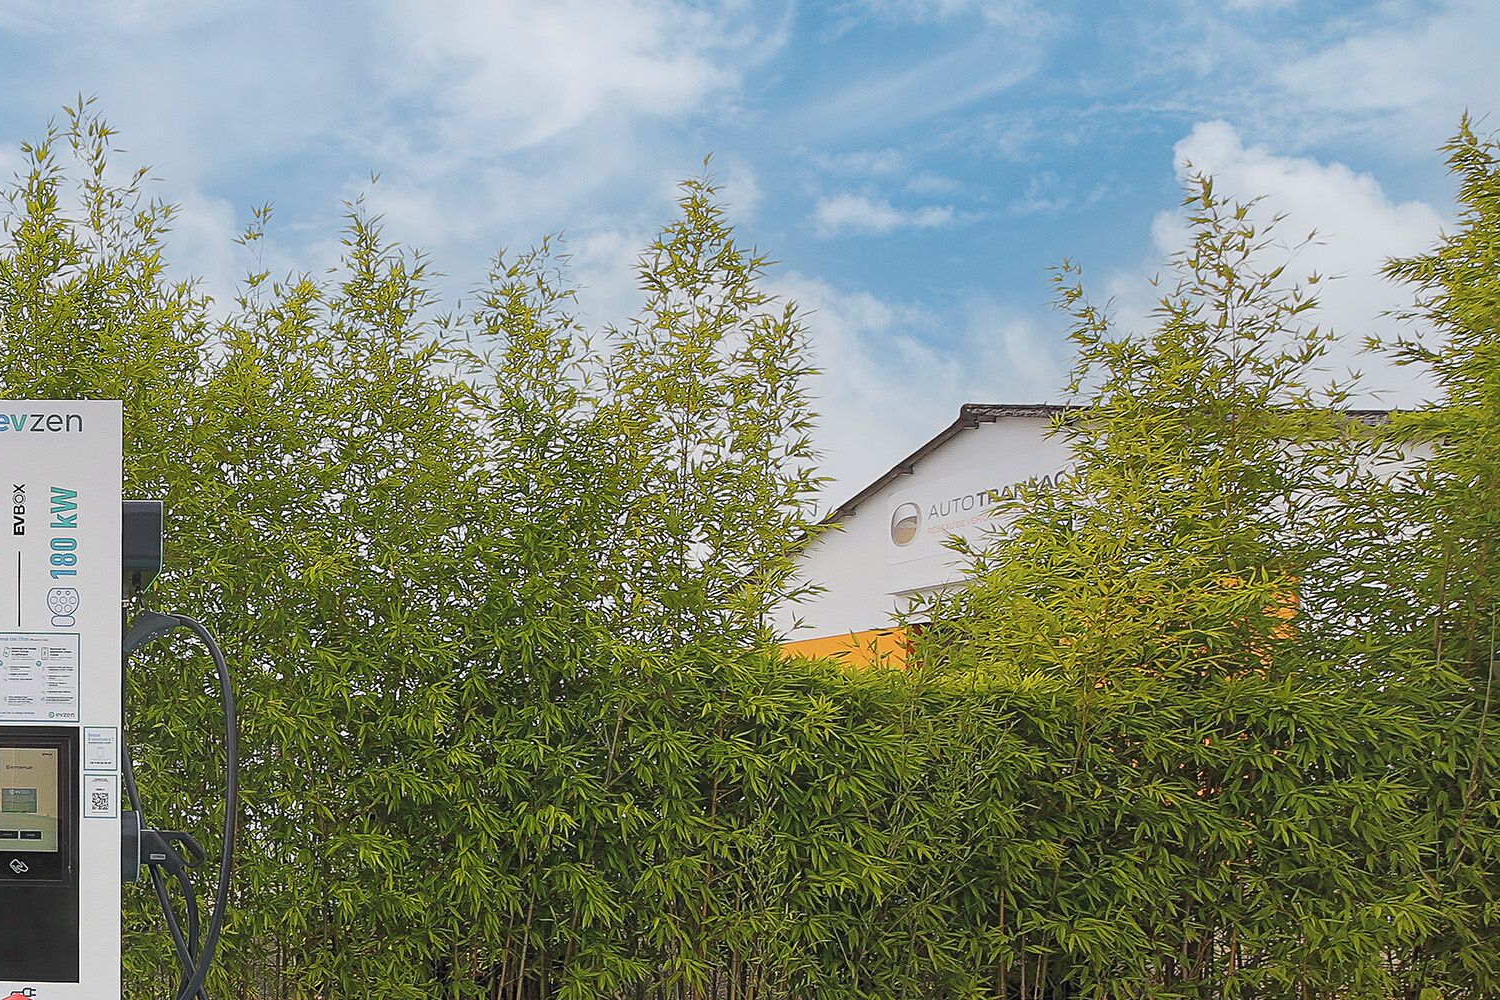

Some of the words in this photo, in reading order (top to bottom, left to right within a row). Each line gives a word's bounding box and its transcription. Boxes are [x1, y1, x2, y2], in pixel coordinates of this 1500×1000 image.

[13, 483, 26, 536] EVBOX
[50, 486, 78, 528] kW
[50, 537, 78, 580] 180
